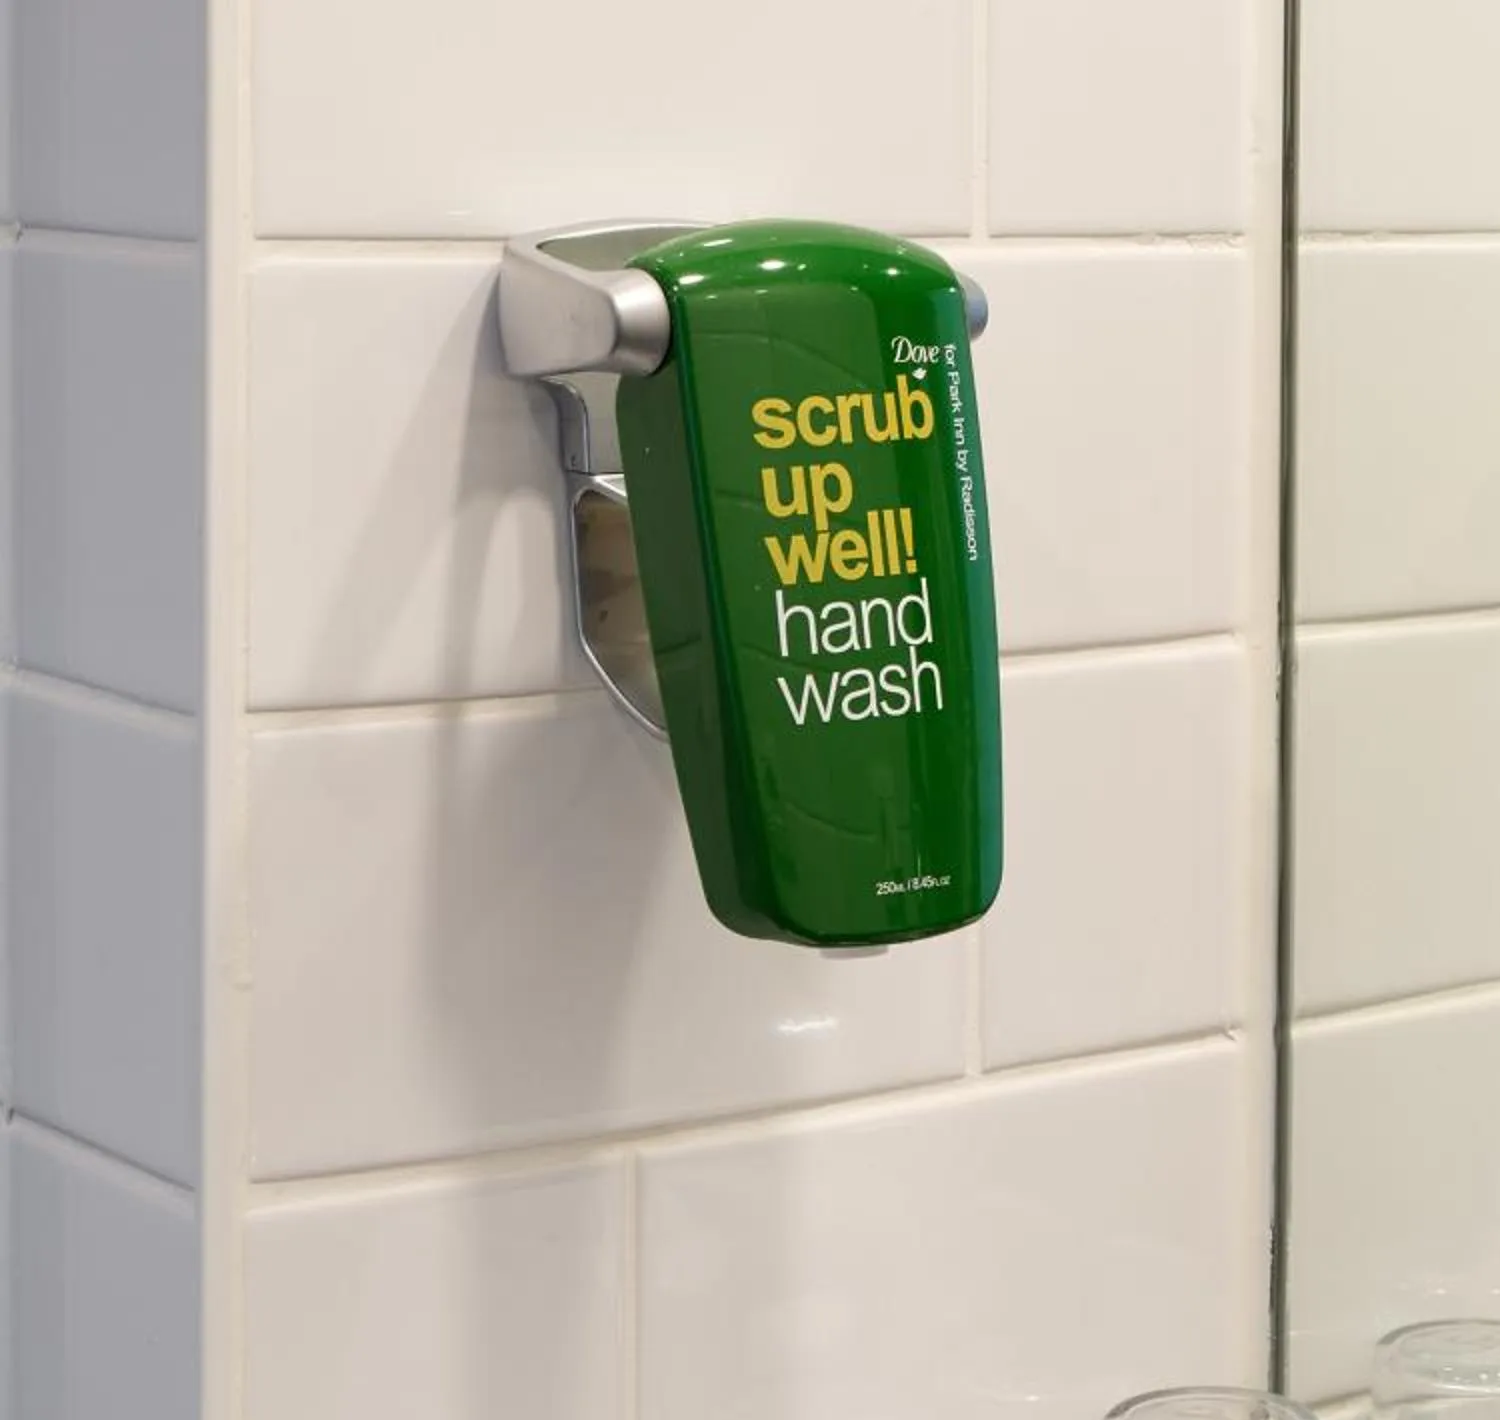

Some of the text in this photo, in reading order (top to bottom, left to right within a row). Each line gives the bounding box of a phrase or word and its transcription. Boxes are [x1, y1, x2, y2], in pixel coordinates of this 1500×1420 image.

[891, 335, 940, 364] Dove
[751, 374, 935, 449] scrub
[944, 343, 978, 562] for Park Inn by Radisson
[761, 462, 853, 532] up
[764, 507, 918, 586] well!
[775, 576, 934, 657] hand
[776, 645, 944, 726] wash
